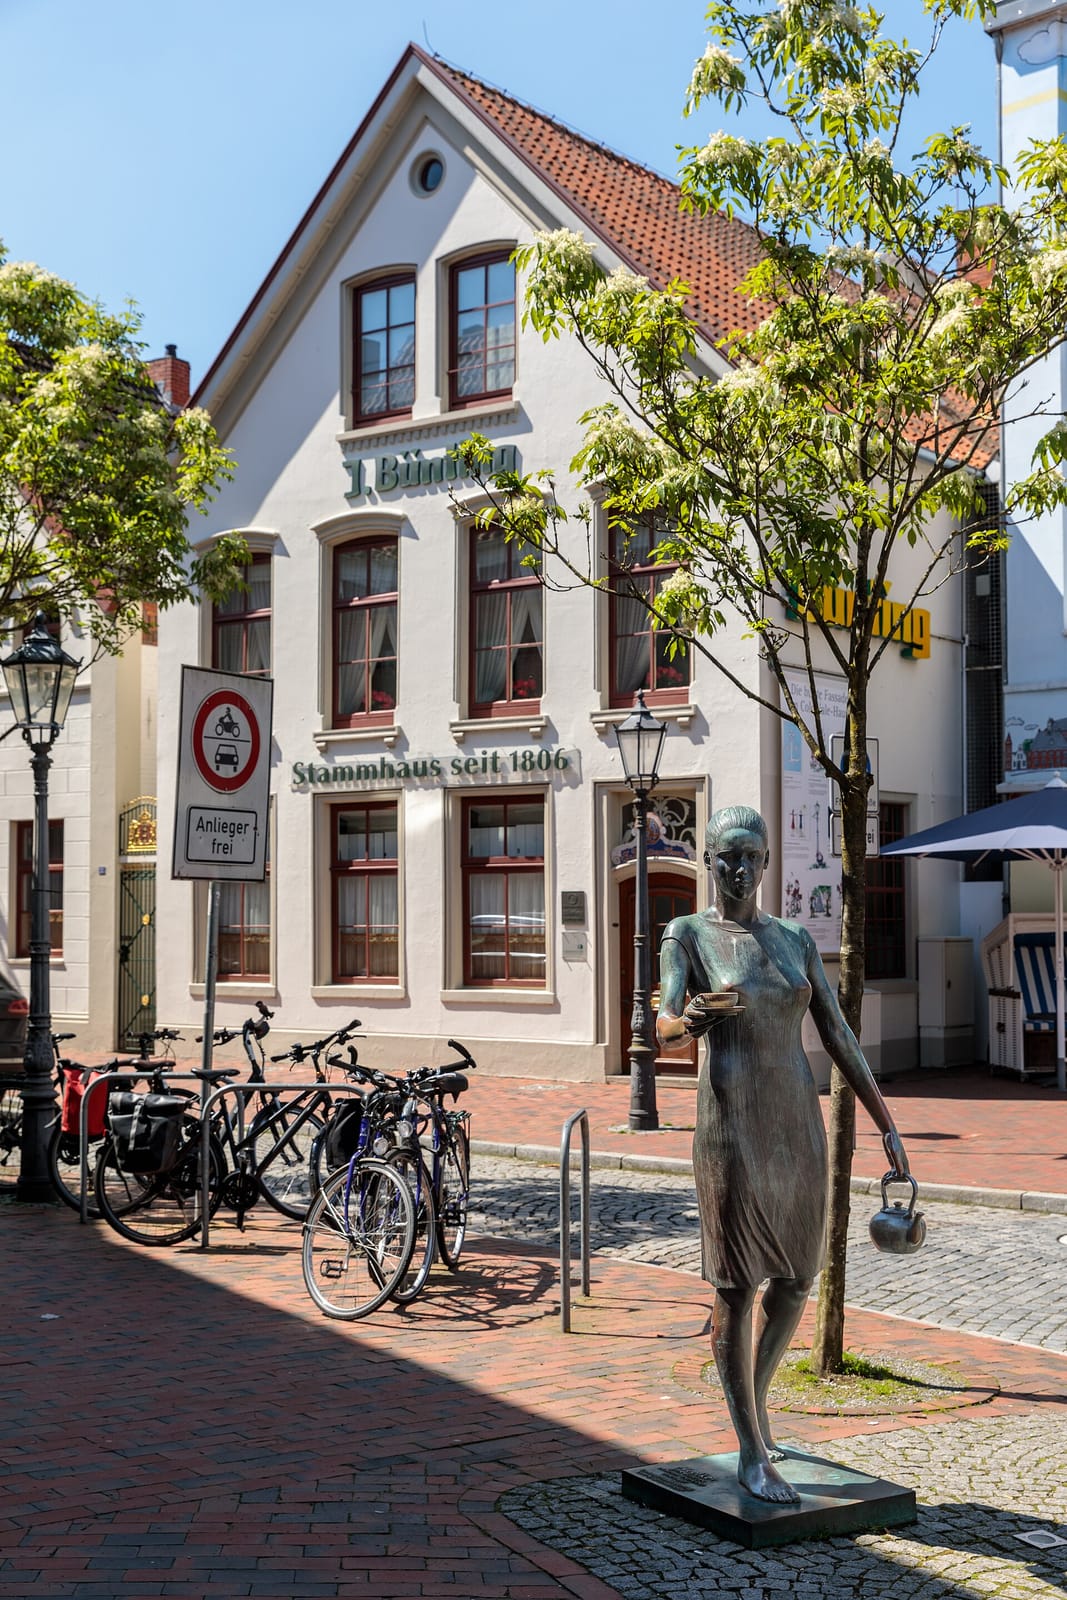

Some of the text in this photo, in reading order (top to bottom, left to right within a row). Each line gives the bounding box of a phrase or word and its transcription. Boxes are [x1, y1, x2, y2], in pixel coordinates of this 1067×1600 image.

[791, 683, 802, 697] Die
[292, 747, 568, 785] Stammhaus seit 1806
[195, 815, 250, 838] Anlieger
[211, 838, 233, 855] frei
